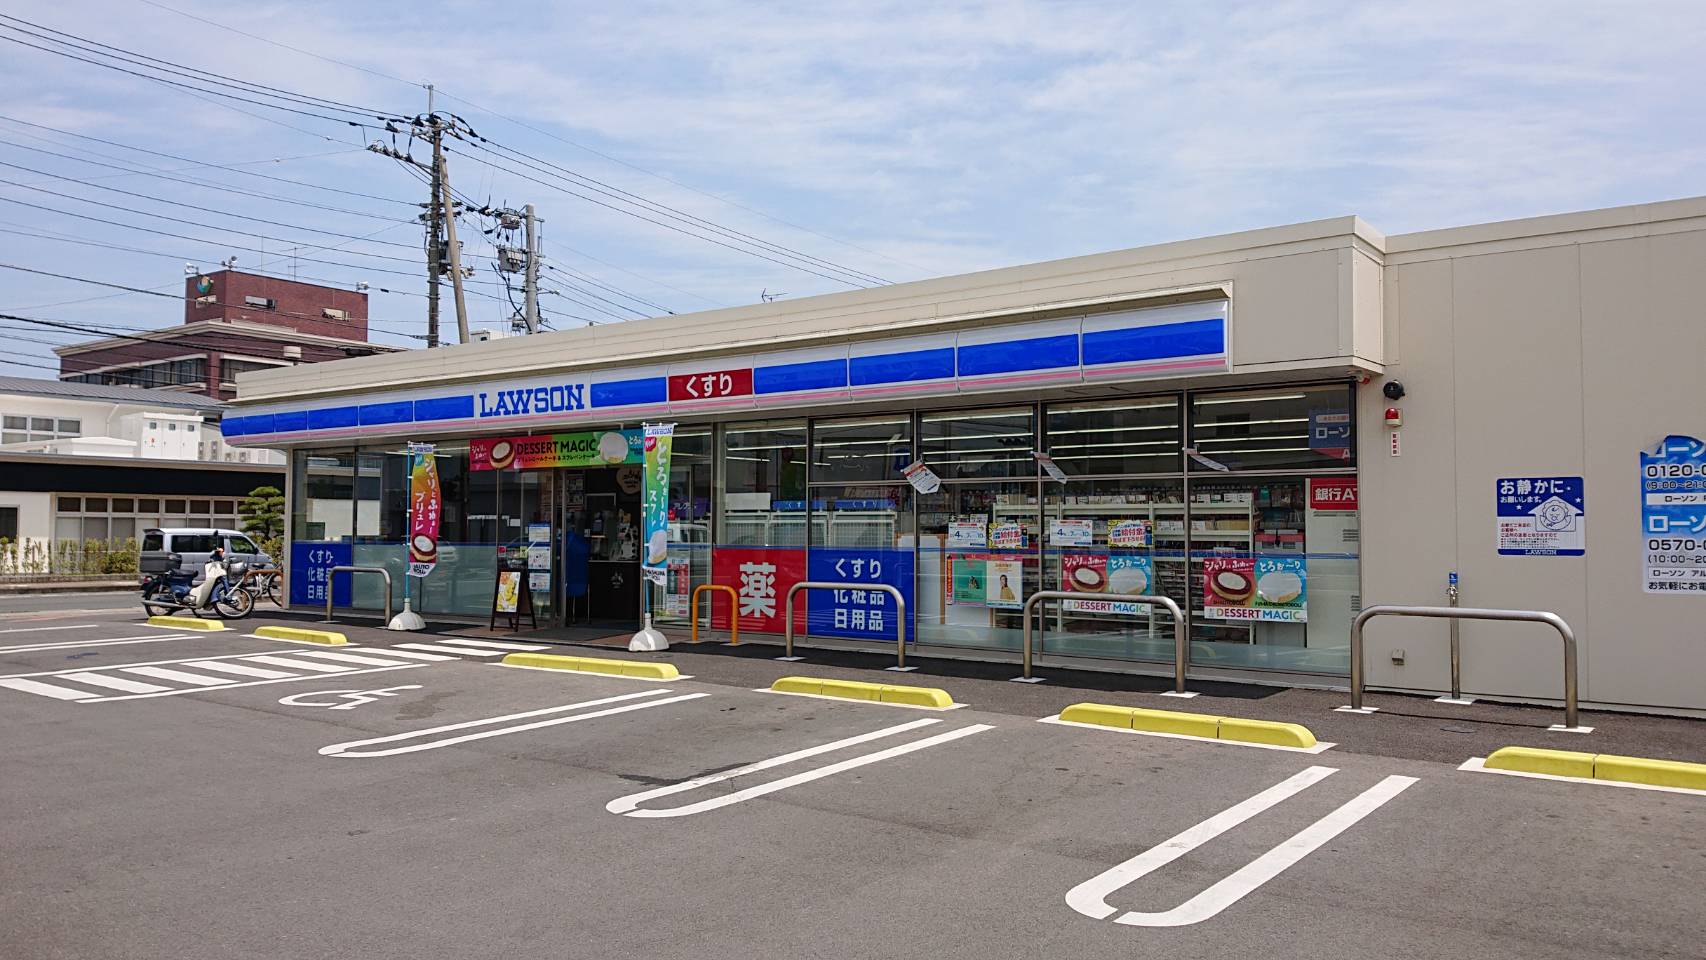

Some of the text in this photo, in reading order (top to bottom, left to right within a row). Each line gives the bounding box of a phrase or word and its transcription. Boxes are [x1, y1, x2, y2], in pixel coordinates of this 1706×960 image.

[686, 373, 732, 398] くすり
[479, 383, 585, 418] LAWSON
[516, 438, 597, 455] DESSERT MAGIC
[1315, 487, 1357, 501] 銀行A
[1501, 479, 1564, 495] お静かに
[1500, 495, 1542, 503] お願いします。
[1649, 515, 1706, 532] ローン
[1649, 539, 1706, 551] 0570-
[309, 549, 333, 564] くすり
[835, 558, 881, 579] くすり
[1653, 569, 1685, 577] ローソン
[308, 585, 329, 600] 日用
[739, 562, 777, 619] 薬
[1073, 601, 1112, 611] DESSERT
[1113, 603, 1146, 613] MAGIC
[1216, 608, 1261, 619] DESSERT
[1262, 610, 1301, 620] MAGIC
[834, 608, 884, 632] 日用品
